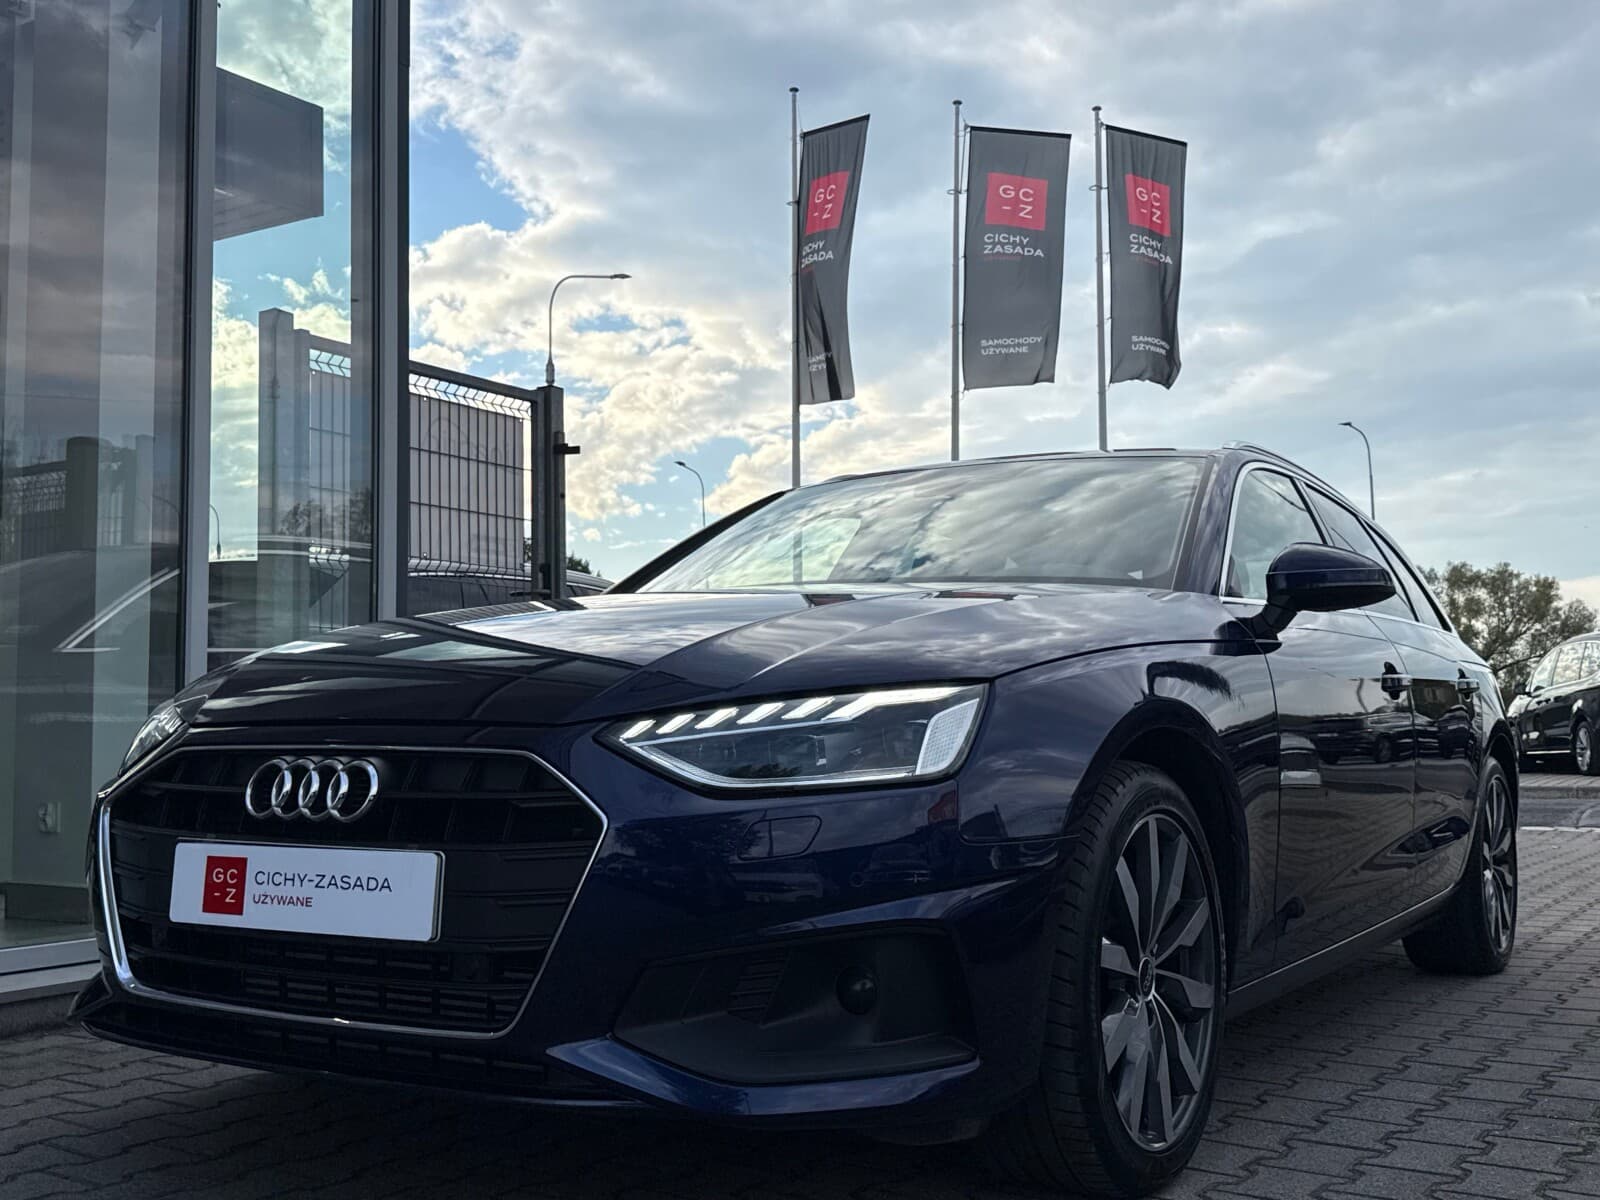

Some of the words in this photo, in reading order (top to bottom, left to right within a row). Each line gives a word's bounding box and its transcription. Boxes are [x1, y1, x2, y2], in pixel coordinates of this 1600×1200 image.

[815, 184, 836, 203] GC
[999, 185, 1034, 201] GC
[1136, 187, 1160, 206] GC
[984, 233, 1029, 245] CICHY
[1130, 233, 1162, 250] CICHY
[984, 244, 1044, 257] ZASADA
[1130, 244, 1173, 265] ZASADA
[981, 336, 1042, 347] SAMOCHODY
[212, 868, 238, 884] GC
[254, 870, 393, 893] CICHY-ZASADA
[252, 891, 313, 908] UŻYWANE
